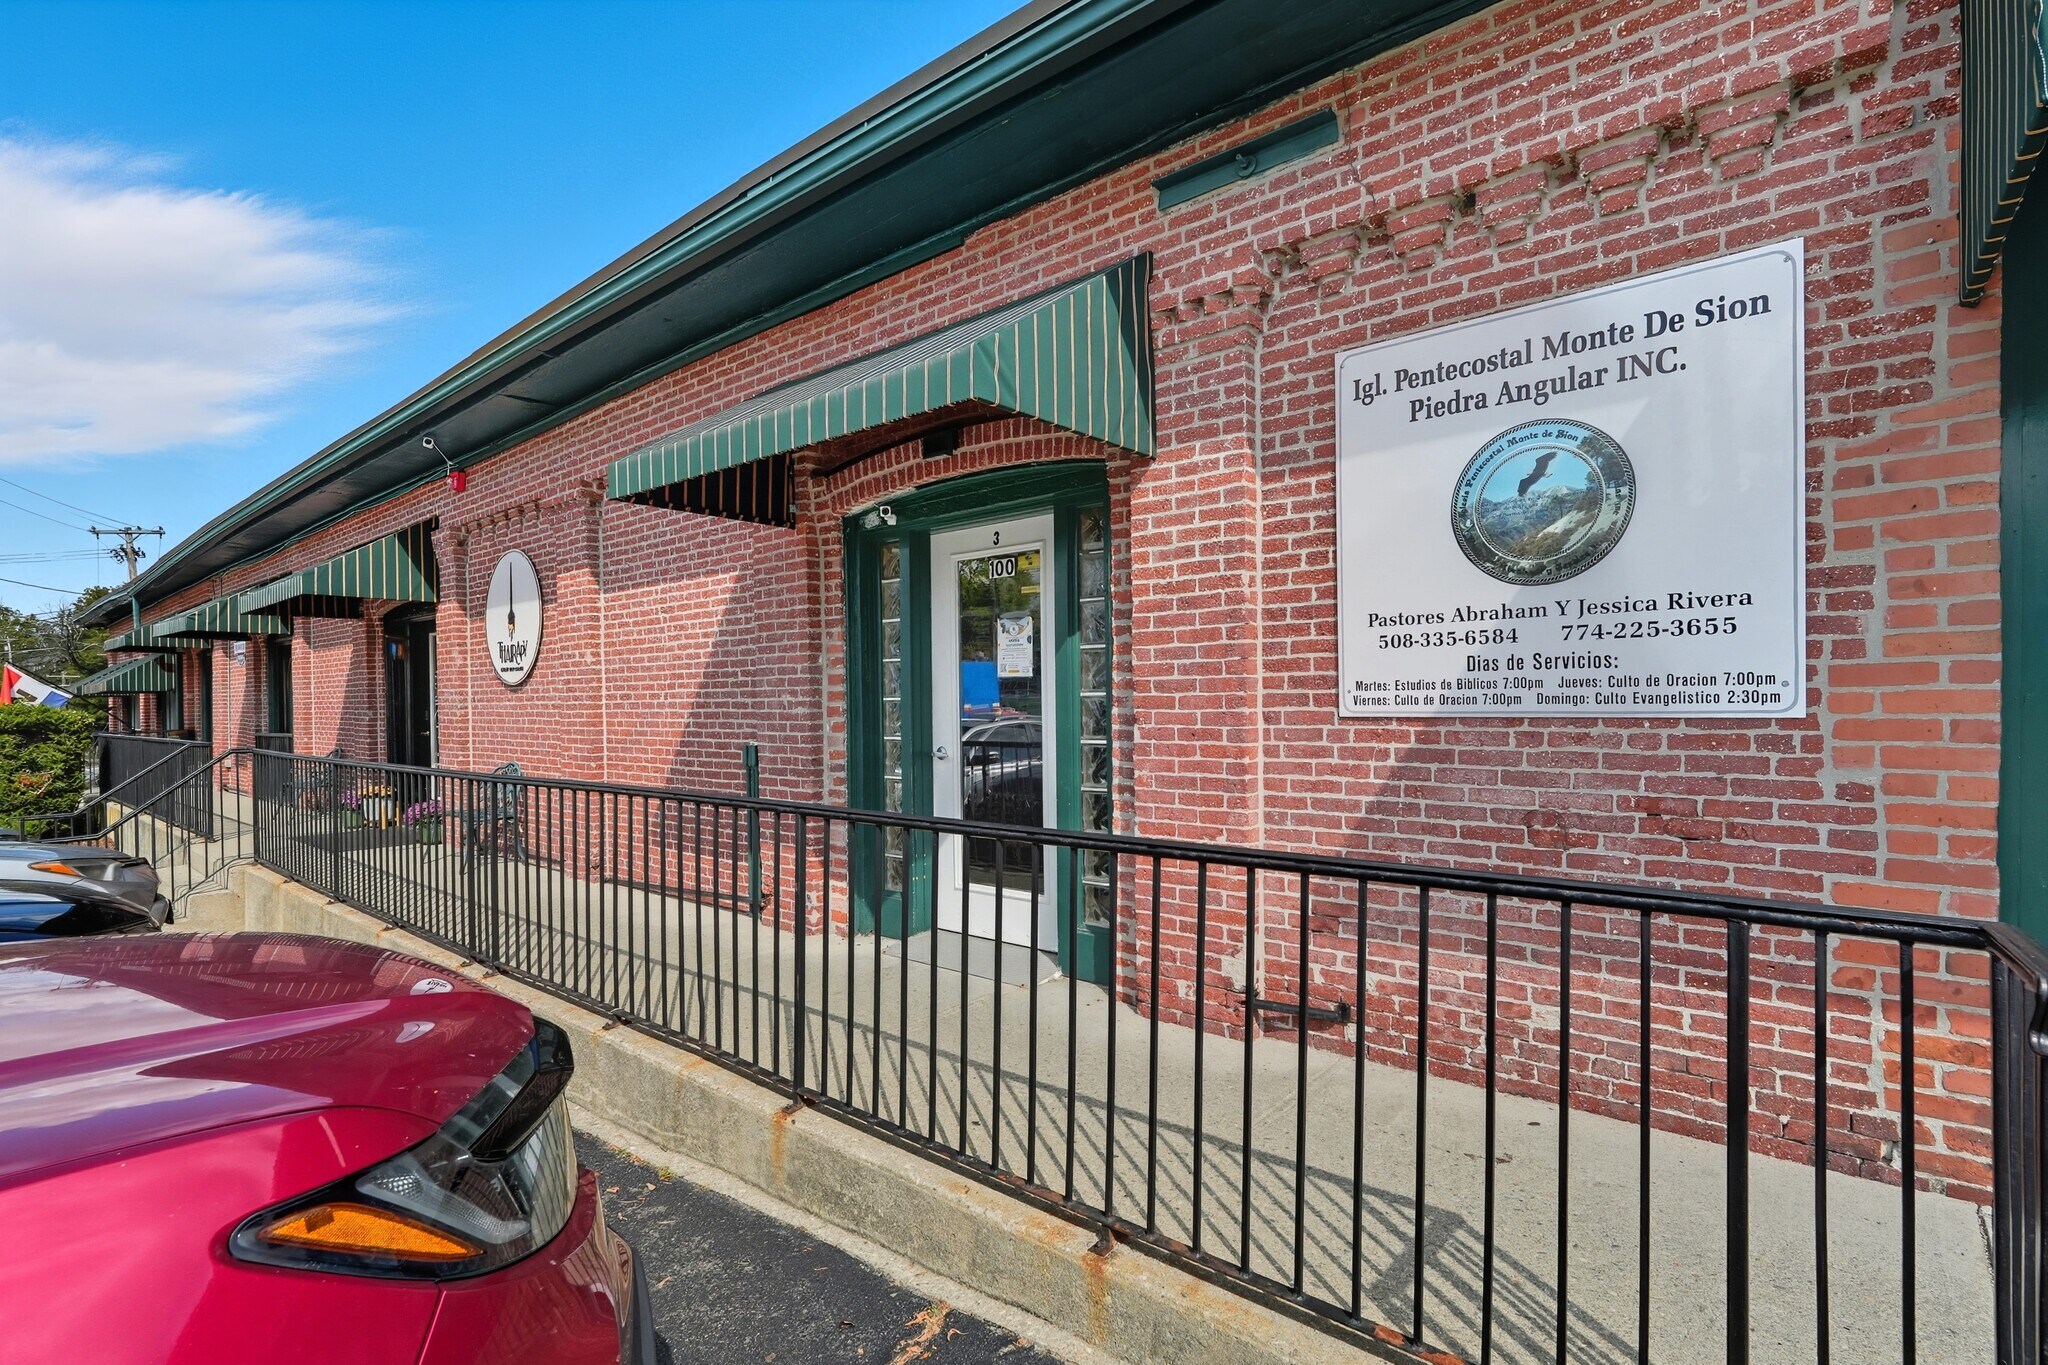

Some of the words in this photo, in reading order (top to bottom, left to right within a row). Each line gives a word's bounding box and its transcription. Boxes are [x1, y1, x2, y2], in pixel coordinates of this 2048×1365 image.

[1353, 376, 1388, 406] Igl.
[1394, 339, 1533, 393] Pentecostal
[1542, 322, 1634, 360] Monte
[1644, 311, 1684, 338] De
[1696, 295, 1771, 326] Sion
[1410, 389, 1488, 422] Piedra
[1495, 366, 1608, 406] Angular
[1617, 347, 1686, 382] INC.
[1463, 444, 1505, 488] Pentecostal
[1507, 432, 1538, 448] Monte
[1541, 429, 1553, 438] de
[993, 531, 999, 545] 3
[990, 558, 1014, 578] 100
[1369, 613, 1444, 627] Pastores
[1451, 604, 1547, 622] Abraham
[1555, 600, 1570, 615] Y
[1578, 596, 1658, 619] Jessica
[1668, 592, 1752, 610] Rivera
[1379, 628, 1518, 648] 508-335-6584
[1562, 617, 1736, 640] 774-225-3655
[1467, 655, 1498, 671] Dias
[1507, 654, 1523, 670] de
[1533, 651, 1618, 670] Servicios:
[1356, 681, 1390, 691] Martes:
[1395, 680, 1436, 690] Estudios
[1441, 679, 1451, 690] de
[1457, 678, 1497, 690] Biblicos
[1503, 677, 1543, 690] 7:00pm
[1558, 676, 1601, 688] Jueves:
[1608, 675, 1639, 687] Culto
[1646, 675, 1659, 687] de
[1667, 673, 1716, 686] Oracion
[1724, 672, 1775, 687] 7:00pm
[1353, 695, 1390, 706] Viernes:
[1395, 694, 1419, 706] Culto
[1424, 695, 1434, 705] de
[1440, 695, 1477, 705] Oracion
[1483, 693, 1521, 707] 7:00pm
[1537, 693, 1589, 706] Domingo:
[1596, 692, 1626, 704] Culto
[1633, 691, 1719, 706] Evangelistico
[1728, 690, 1780, 705] 2:30pm
